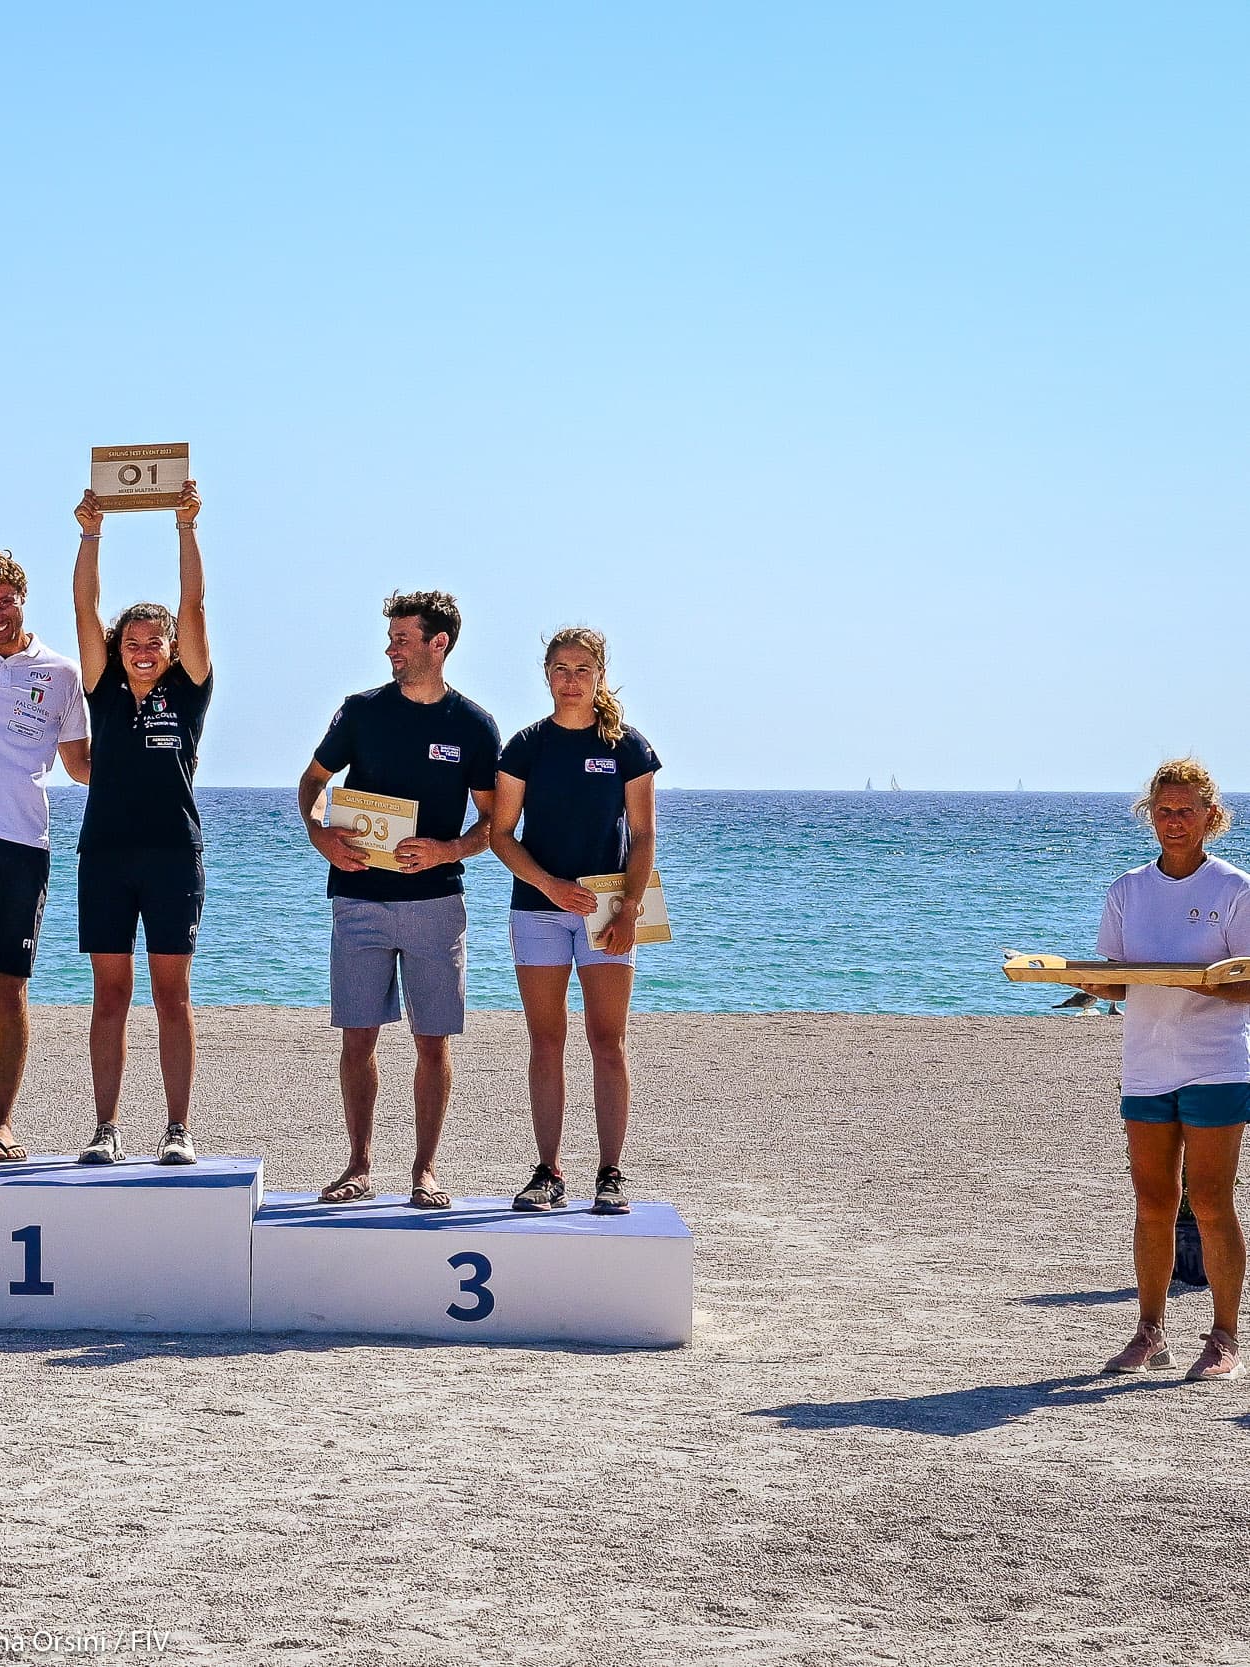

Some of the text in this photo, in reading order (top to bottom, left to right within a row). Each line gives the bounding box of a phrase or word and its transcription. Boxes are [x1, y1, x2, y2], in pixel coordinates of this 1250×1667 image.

[118, 464, 158, 486] 01
[10, 1225, 54, 1296] 1
[446, 1252, 495, 1322] 3
